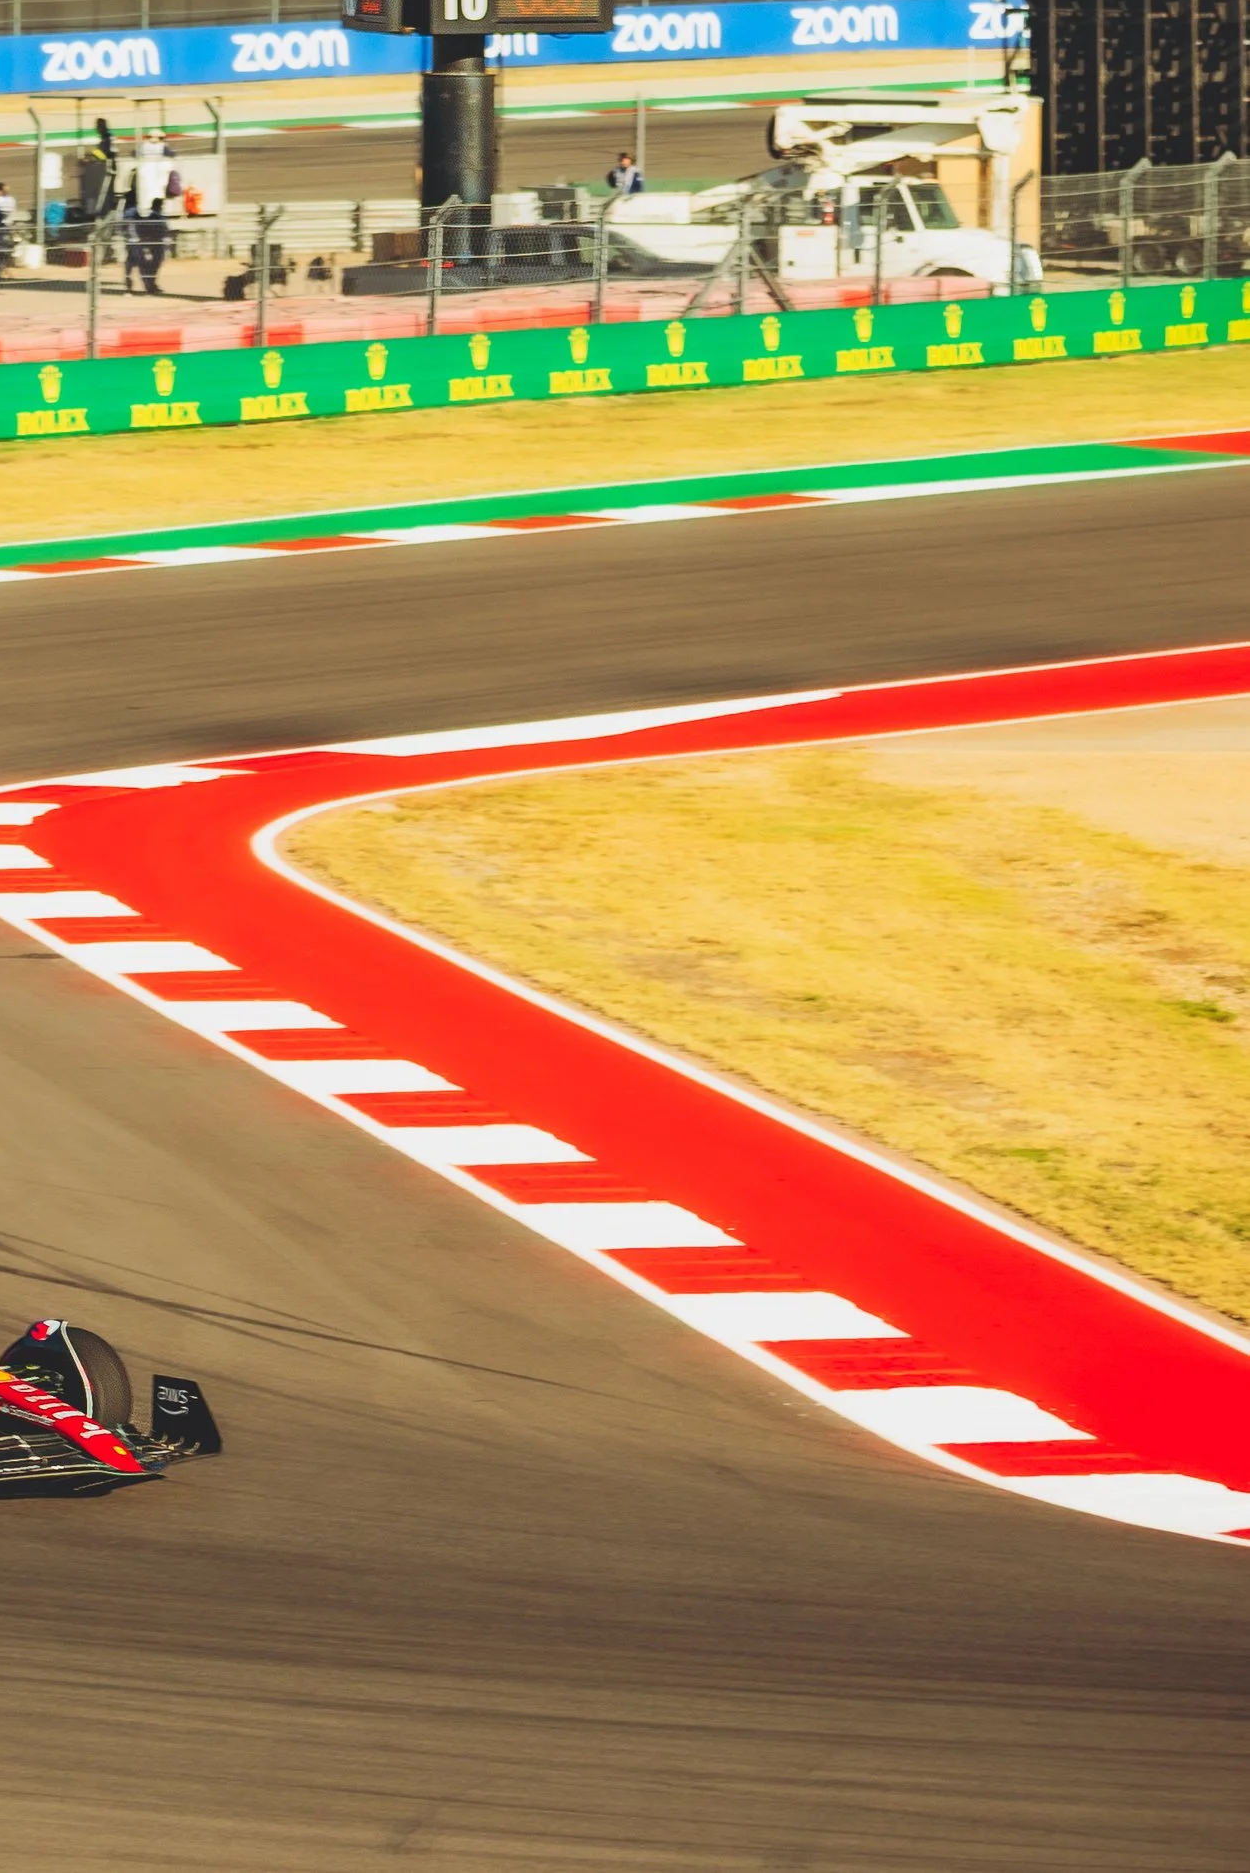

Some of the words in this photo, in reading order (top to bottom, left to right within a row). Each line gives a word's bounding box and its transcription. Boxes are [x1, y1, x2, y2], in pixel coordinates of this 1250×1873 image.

[611, 10, 721, 53] zoom
[790, 3, 899, 46] zoom
[41, 37, 160, 82] zoom
[231, 27, 350, 73] zoom
[345, 383, 413, 413] ROLEX
[448, 374, 514, 402] ROLEX
[130, 401, 203, 429] ROLEX
[240, 391, 311, 420] ROLEX
[16, 407, 90, 436] ROLEX
